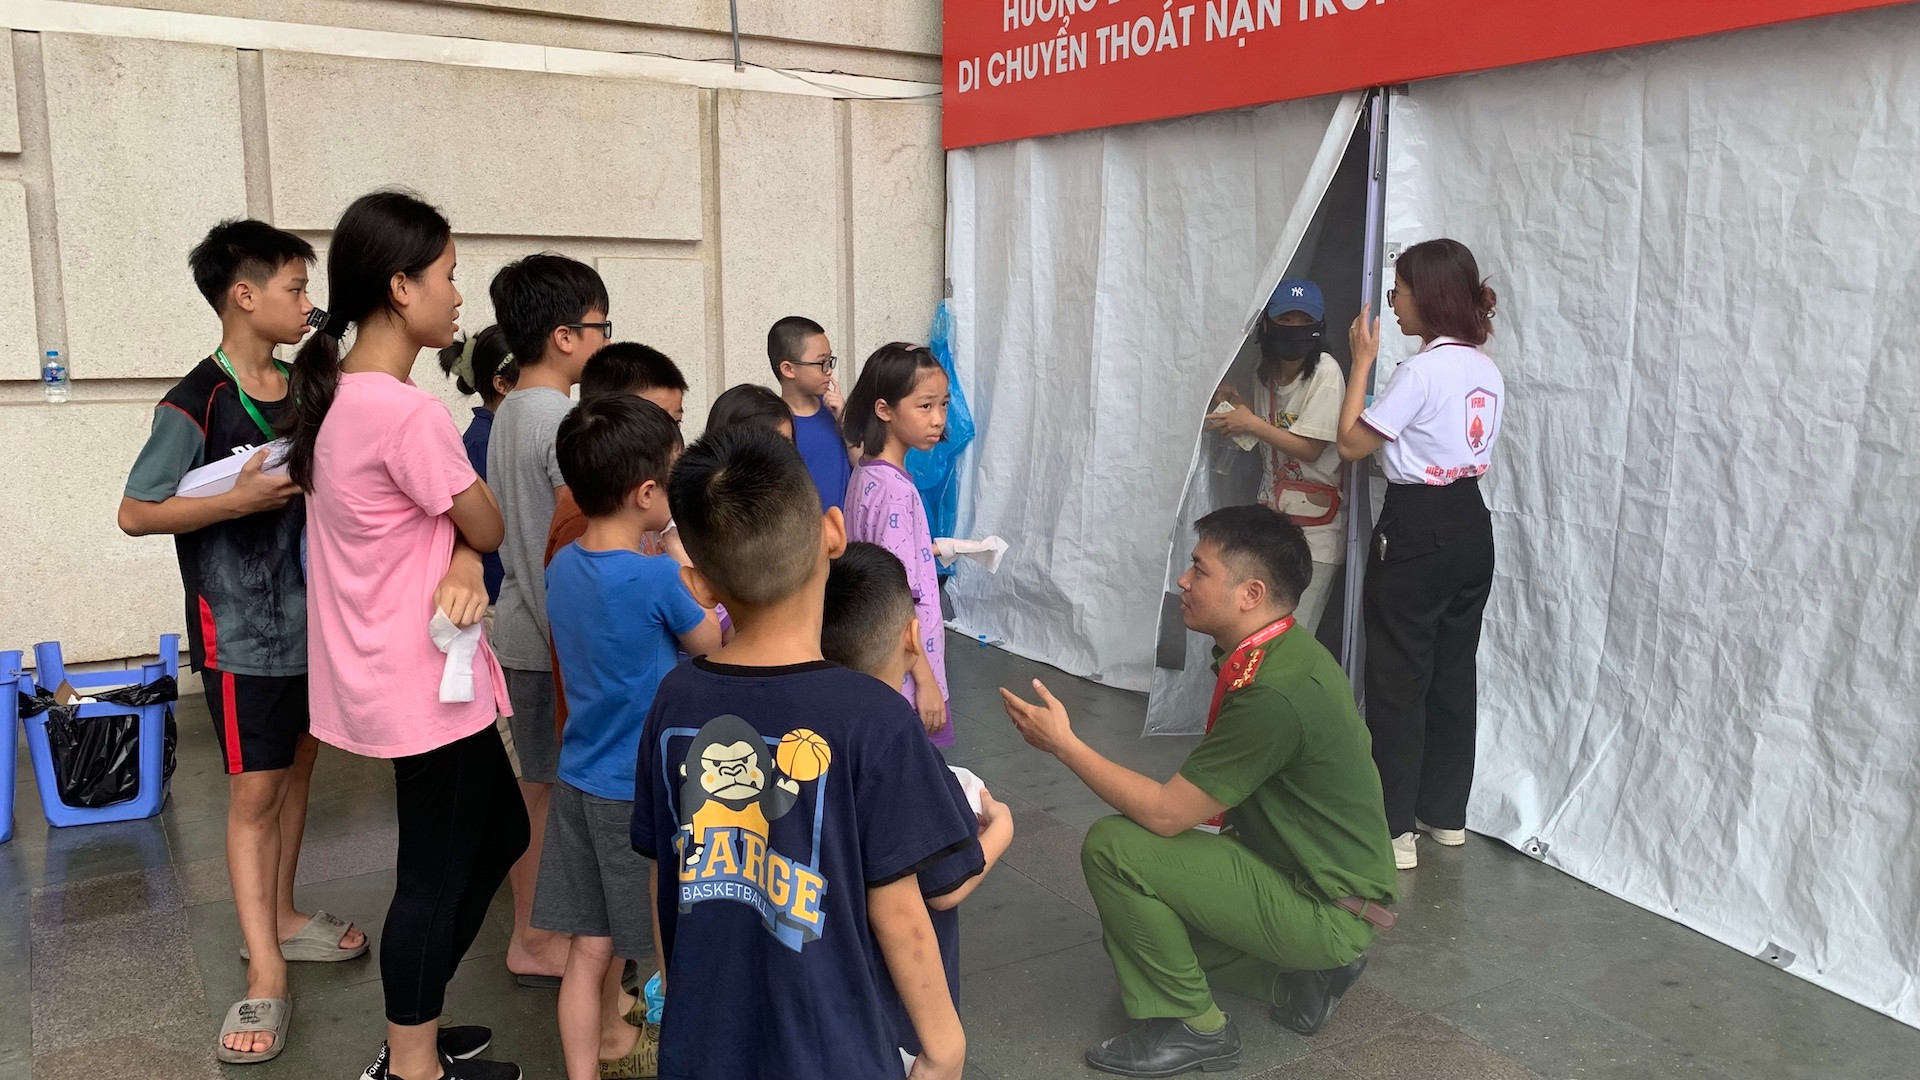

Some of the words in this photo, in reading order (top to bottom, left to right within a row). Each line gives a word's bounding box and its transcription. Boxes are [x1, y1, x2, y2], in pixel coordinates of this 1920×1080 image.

[958, 57, 980, 93] DI
[987, 15, 1088, 87] CHUYỂN
[1096, 0, 1195, 65] THOÁT
[1205, 0, 1281, 48] NẠN
[675, 830, 824, 924] LARGE
[682, 882, 768, 917] BASKETBALL
